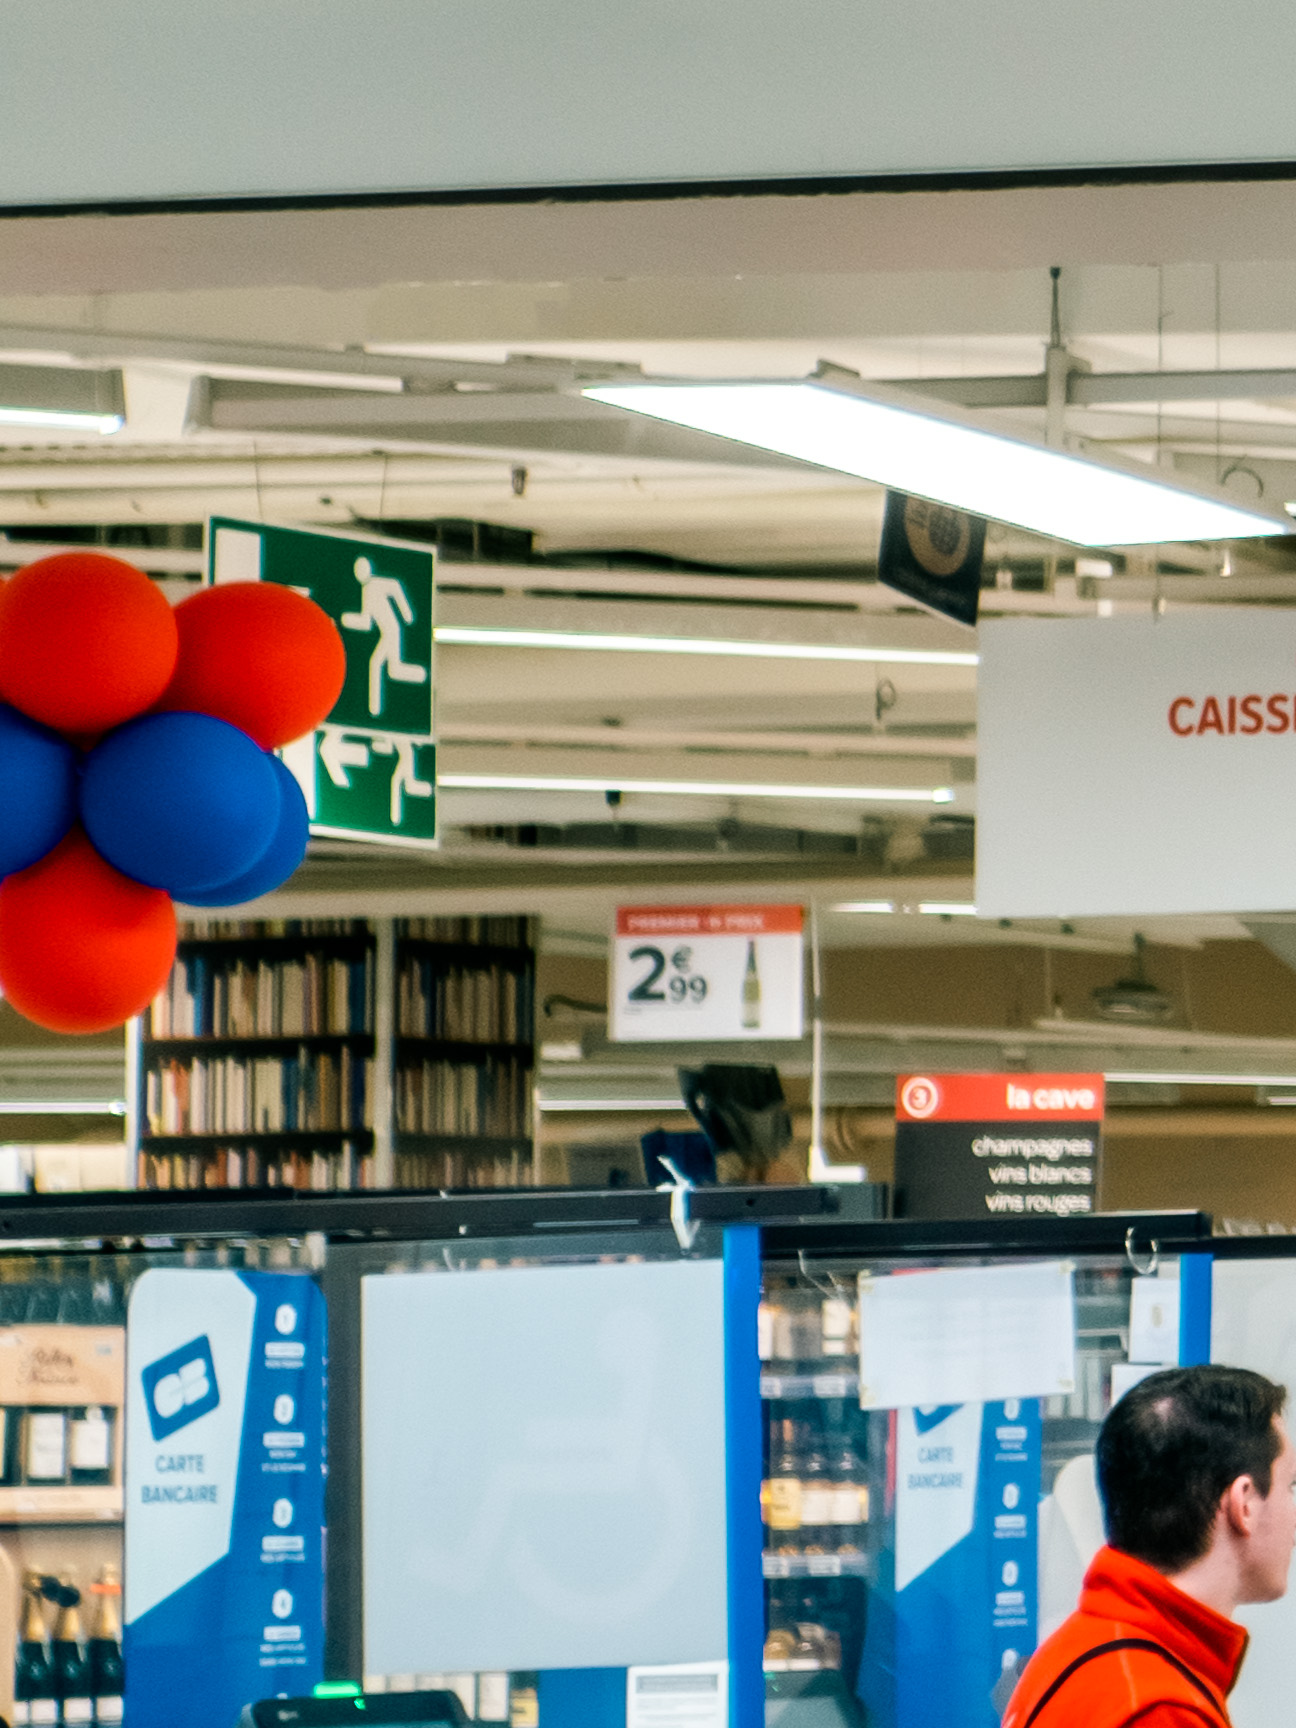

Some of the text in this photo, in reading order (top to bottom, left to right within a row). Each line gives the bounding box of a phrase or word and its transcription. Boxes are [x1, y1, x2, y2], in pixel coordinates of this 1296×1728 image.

[1007, 1083, 1095, 1110] la cave
[972, 1135, 1093, 1161] champagnes
[988, 1162, 1092, 1185] vins blancs
[985, 1190, 1091, 1217] vins rouges
[155, 1454, 204, 1473] CARTE
[141, 1485, 218, 1504] BANCAIRE
